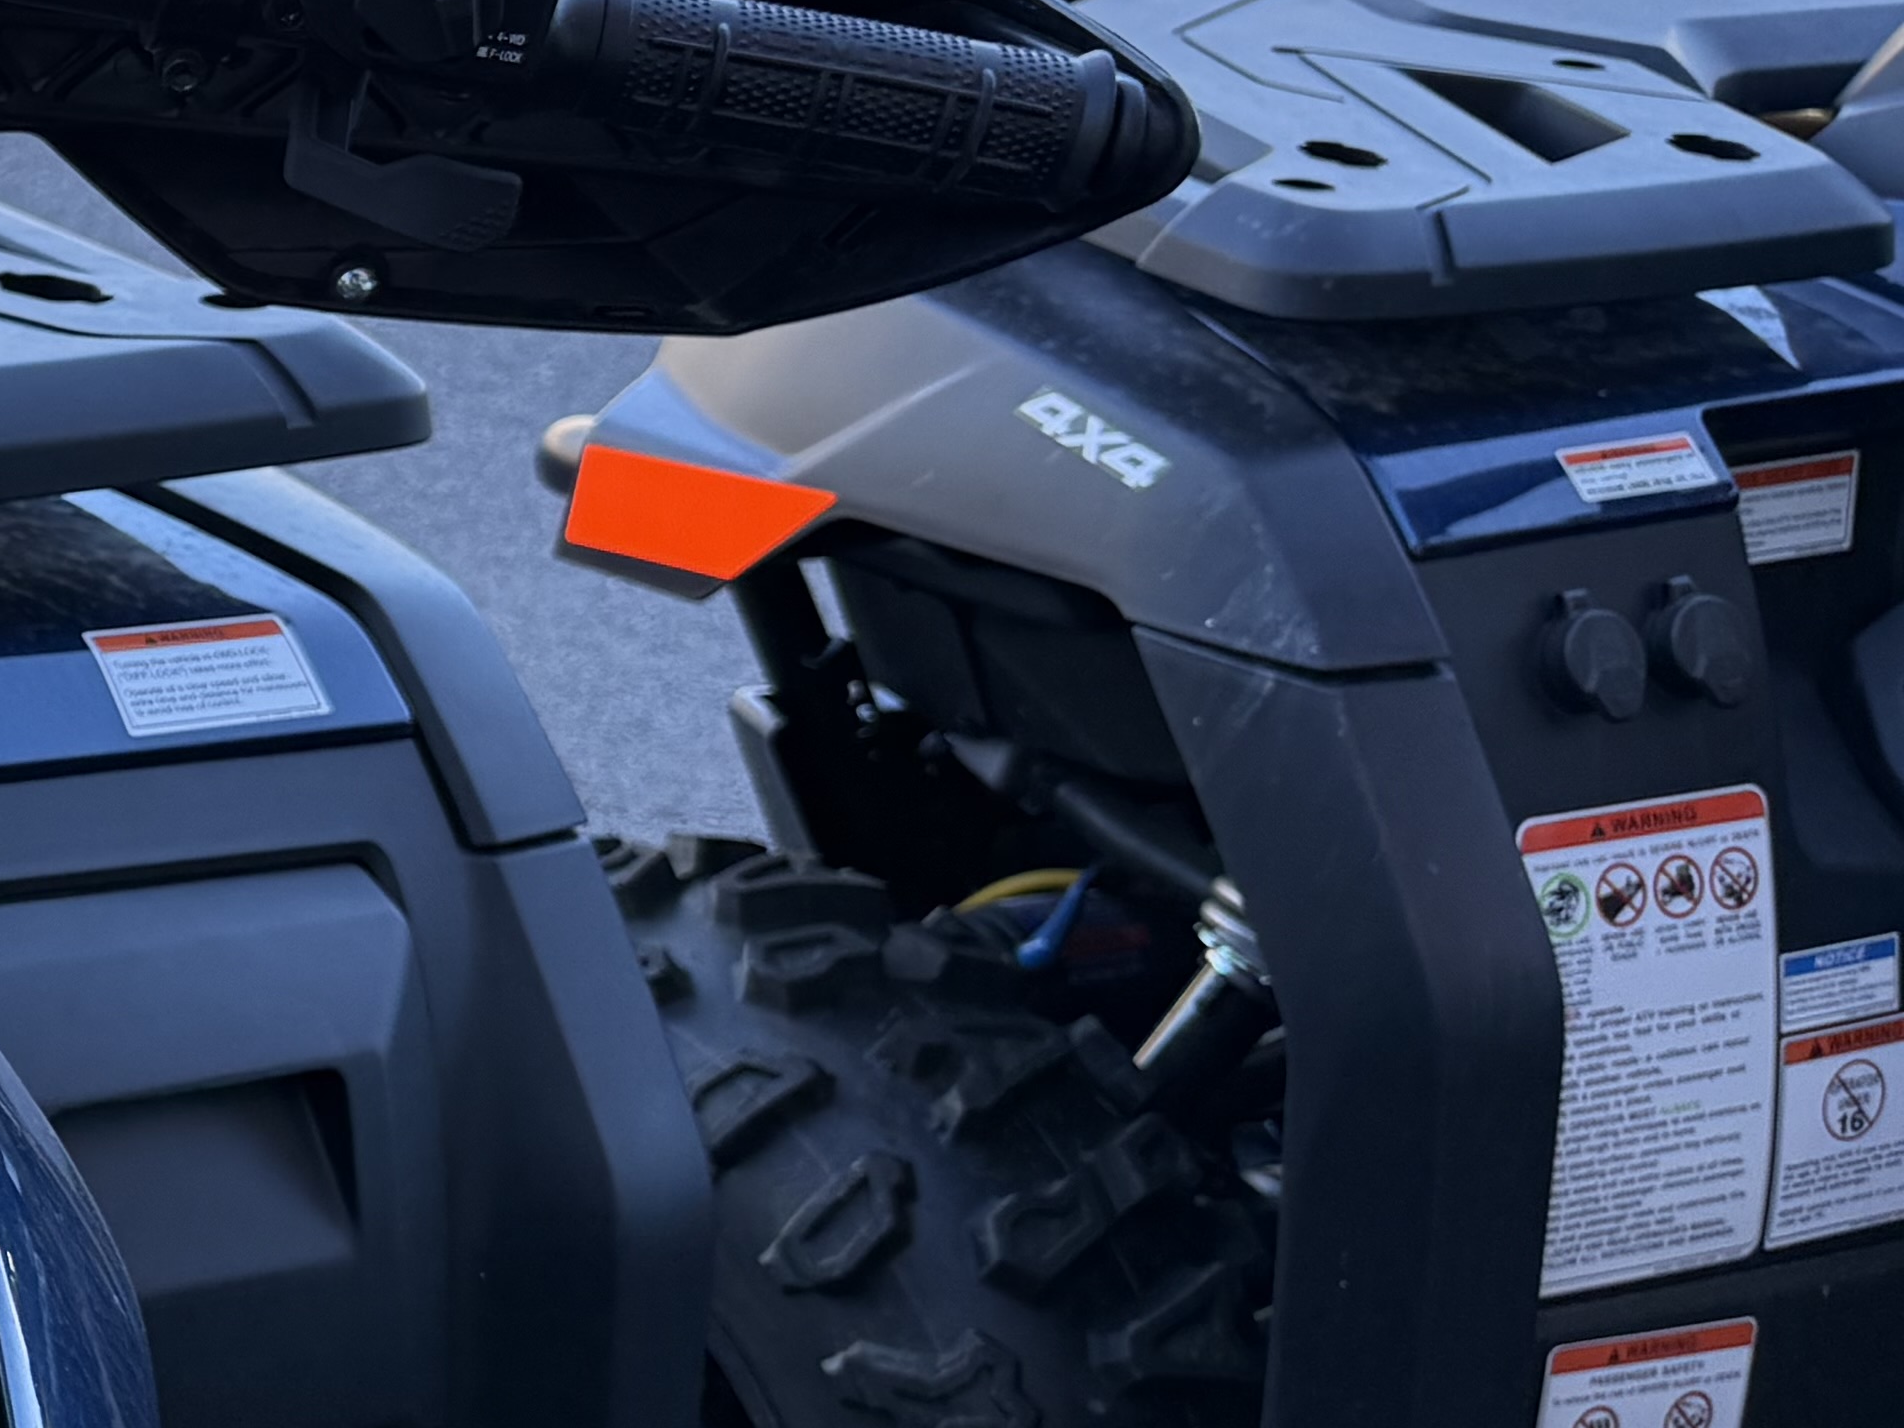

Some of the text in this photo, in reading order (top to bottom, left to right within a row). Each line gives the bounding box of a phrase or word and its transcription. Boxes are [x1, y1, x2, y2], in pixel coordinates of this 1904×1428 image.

[1610, 805, 1699, 834] WARNING
[1813, 944, 1868, 969] NOTICE
[1837, 1109, 1866, 1135] 16
